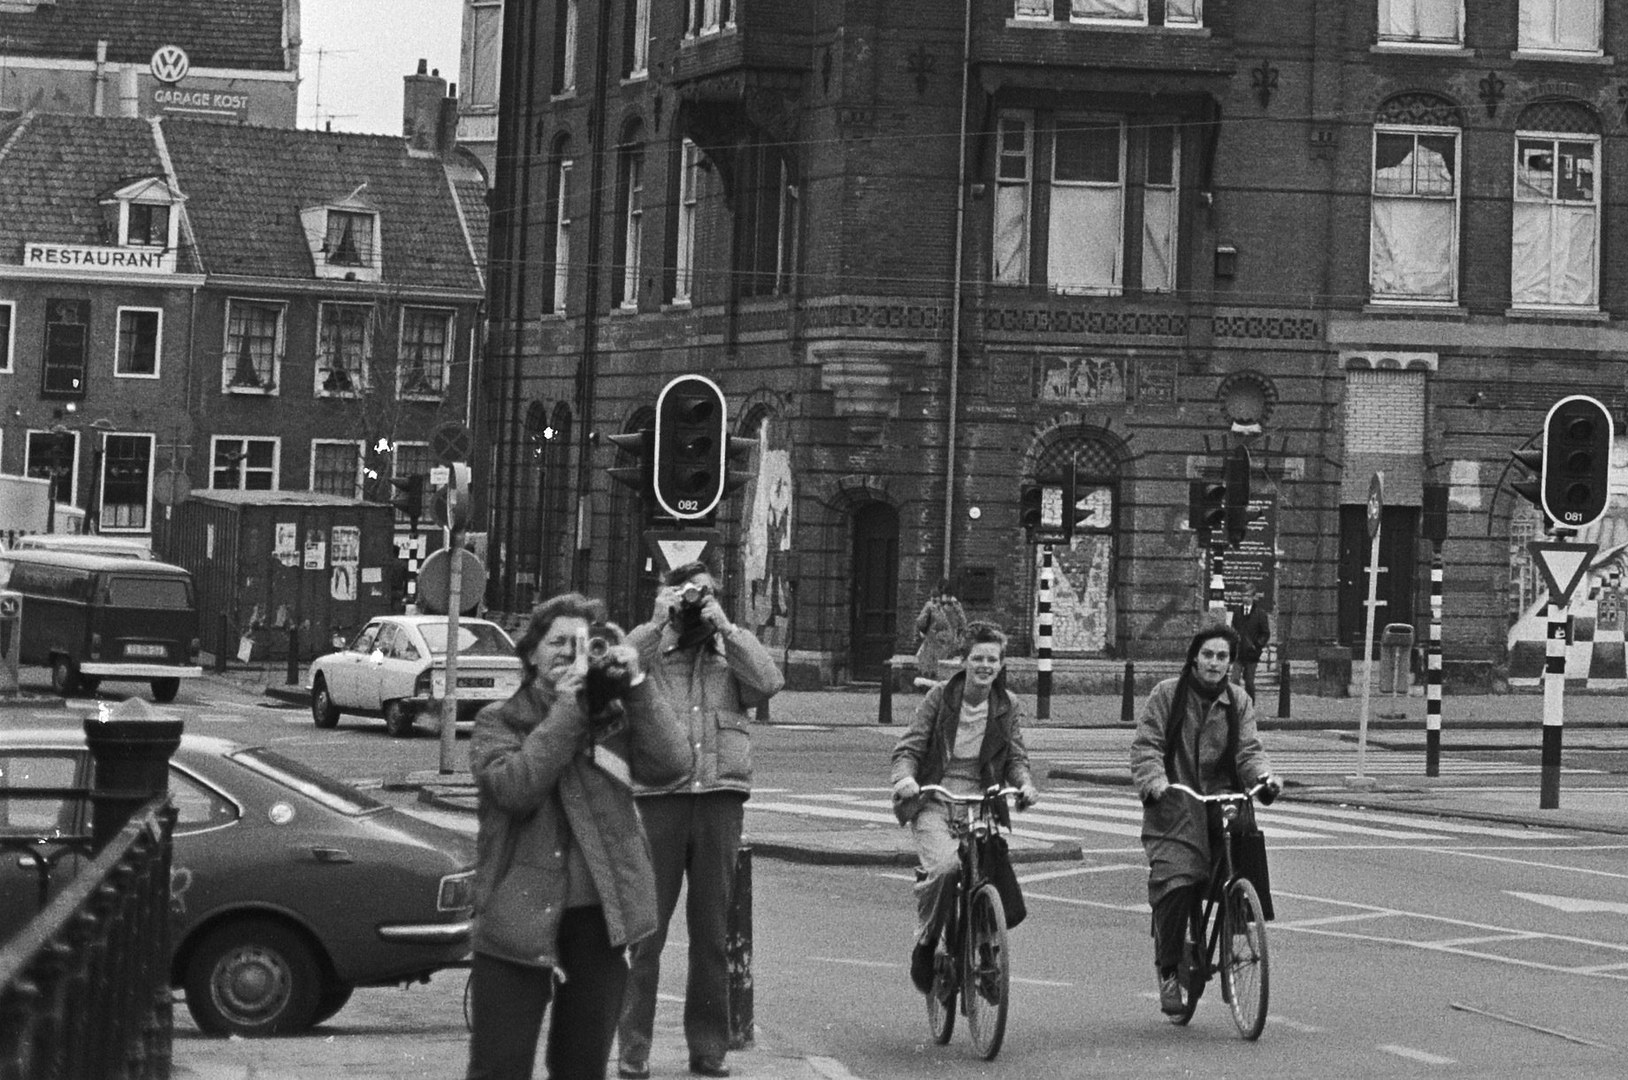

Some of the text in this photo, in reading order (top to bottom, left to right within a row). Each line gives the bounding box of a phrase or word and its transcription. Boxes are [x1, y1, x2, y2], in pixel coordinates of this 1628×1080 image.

[154, 89, 249, 109] GARAGE KOST
[30, 247, 164, 268] RESTAURANT
[678, 500, 699, 511] 082
[1564, 512, 1583, 522] 081
